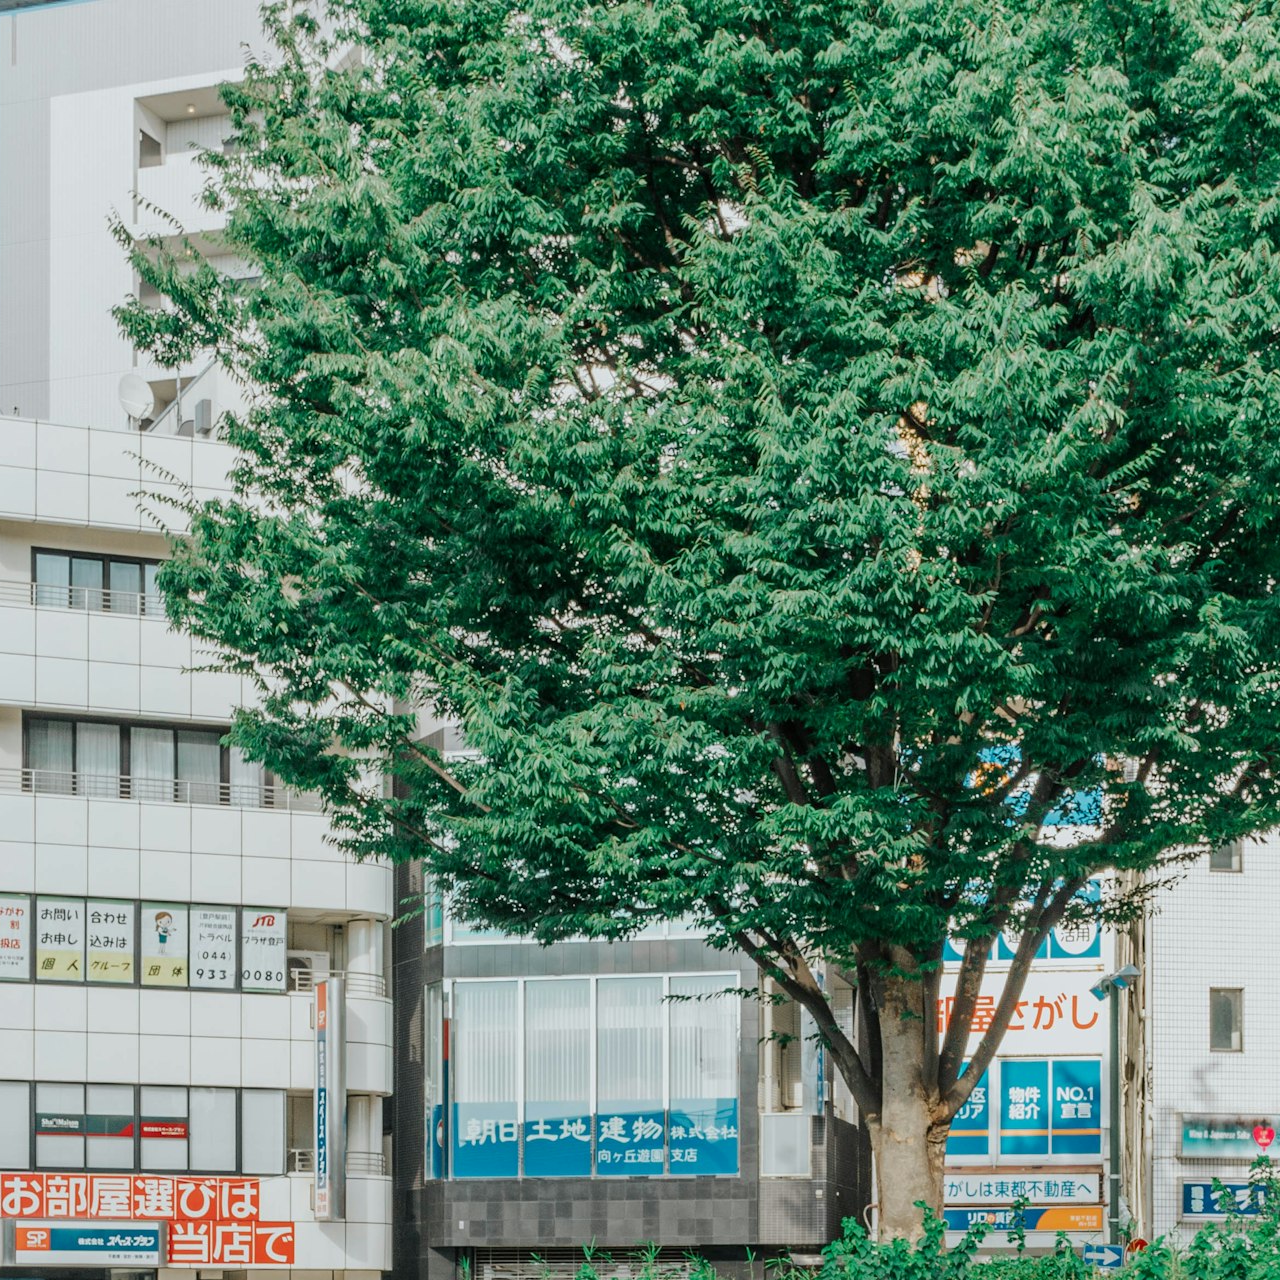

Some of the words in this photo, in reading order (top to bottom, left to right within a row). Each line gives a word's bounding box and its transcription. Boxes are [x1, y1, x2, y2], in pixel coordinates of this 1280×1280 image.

[41, 908, 78, 921] お問い
[90, 911, 127, 925] 合わせ
[252, 914, 275, 928] JTB
[41, 932, 78, 946] お申し
[90, 934, 127, 948] 込みは
[198, 933, 232, 943] トラベル
[197, 951, 232, 961] (044)
[242, 970, 283, 982] 0080
[1009, 1087, 1041, 1100] 物件
[1057, 1087, 1094, 1100] NO.1
[1009, 1105, 1040, 1120] 紹介
[1061, 1103, 1091, 1118] 宣言
[2, 1176, 259, 1218] お部屋選びは
[78, 1237, 104, 1246] 株式会社
[172, 1223, 294, 1263] 当店で
